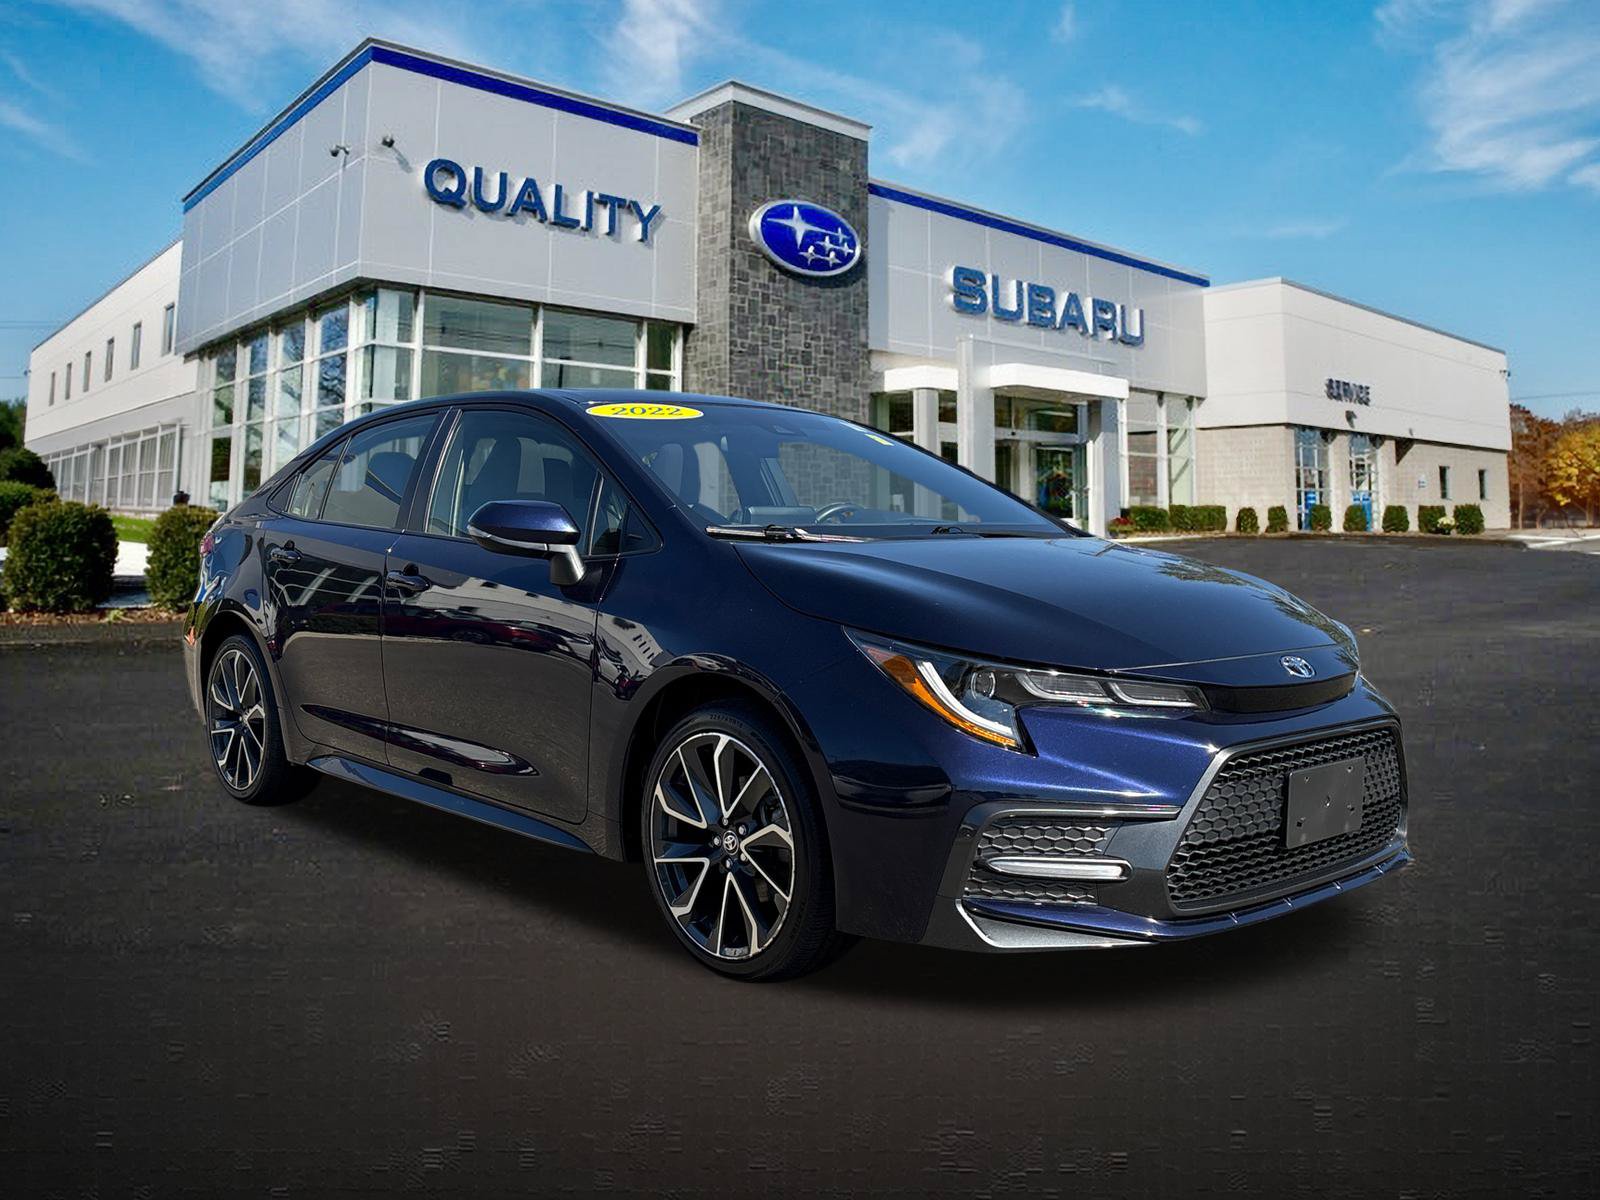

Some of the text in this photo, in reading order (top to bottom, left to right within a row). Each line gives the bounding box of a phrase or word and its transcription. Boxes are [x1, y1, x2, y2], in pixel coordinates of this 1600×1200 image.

[423, 158, 662, 243] QUALITY
[948, 265, 1145, 346] SUBARU
[611, 406, 684, 416] 2022
[1325, 378, 1371, 406] SERVICE
